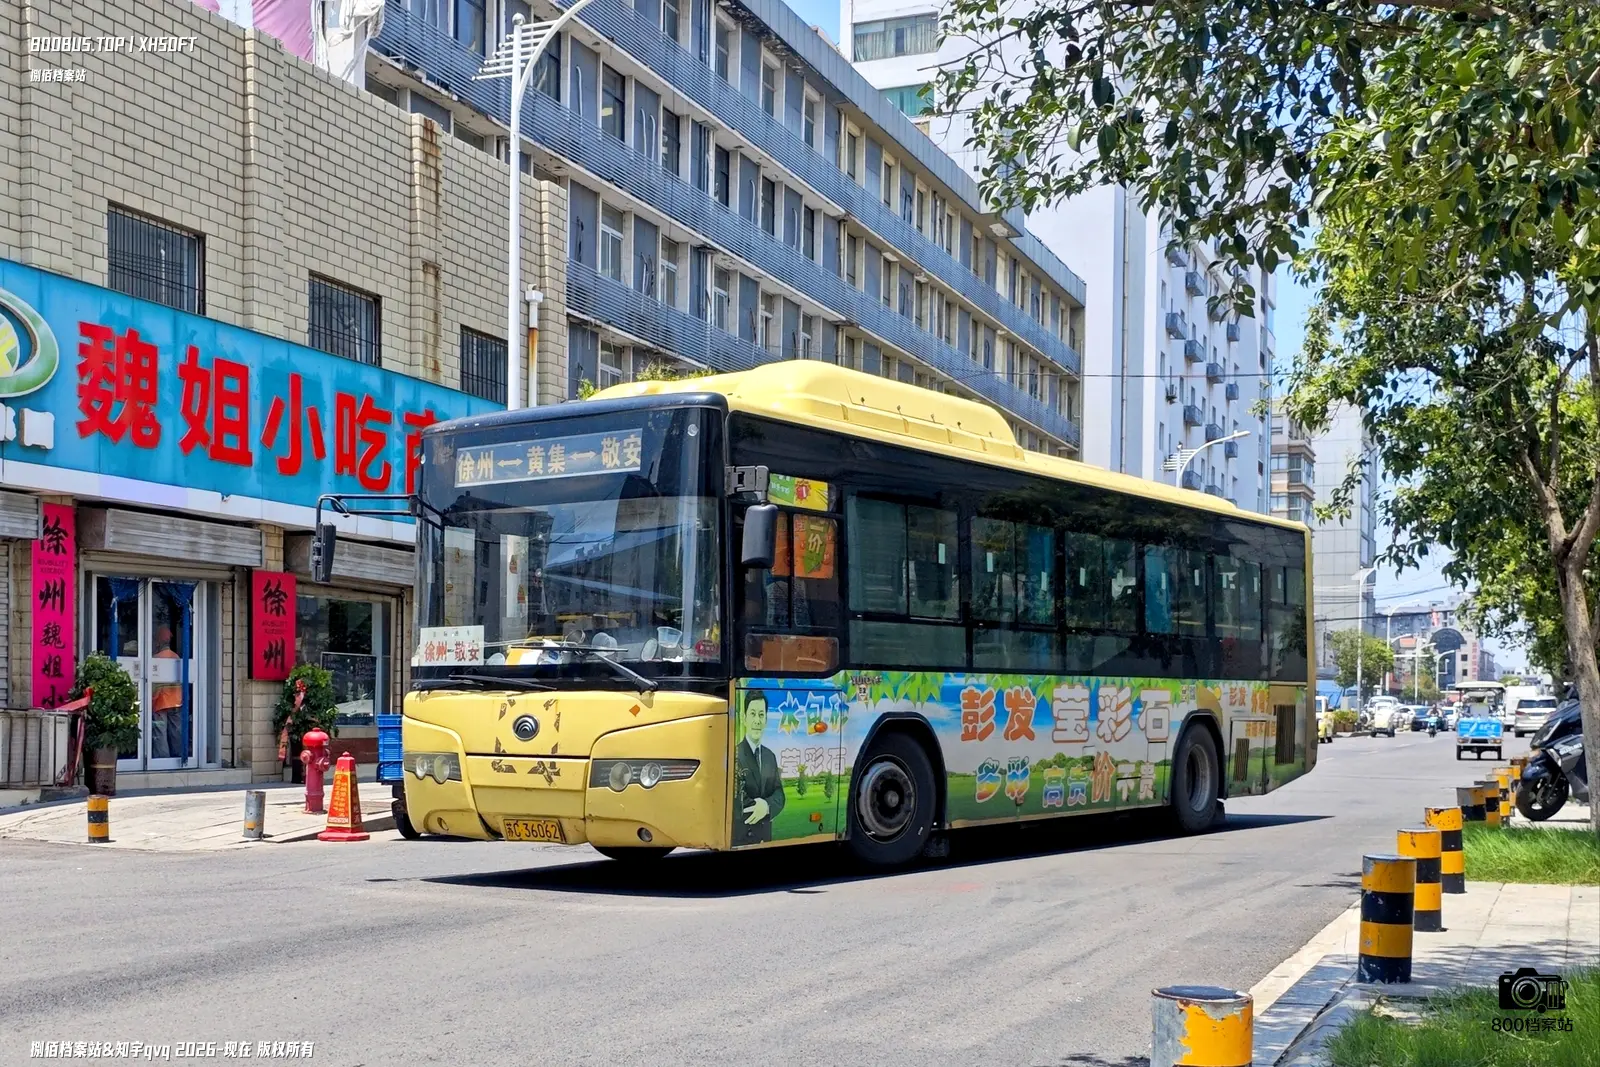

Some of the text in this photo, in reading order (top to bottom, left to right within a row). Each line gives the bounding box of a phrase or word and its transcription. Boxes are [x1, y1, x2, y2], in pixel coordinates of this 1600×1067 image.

[457, 435, 642, 481] 徐州 黄集 敬安
[960, 686, 1037, 742] 彭发
